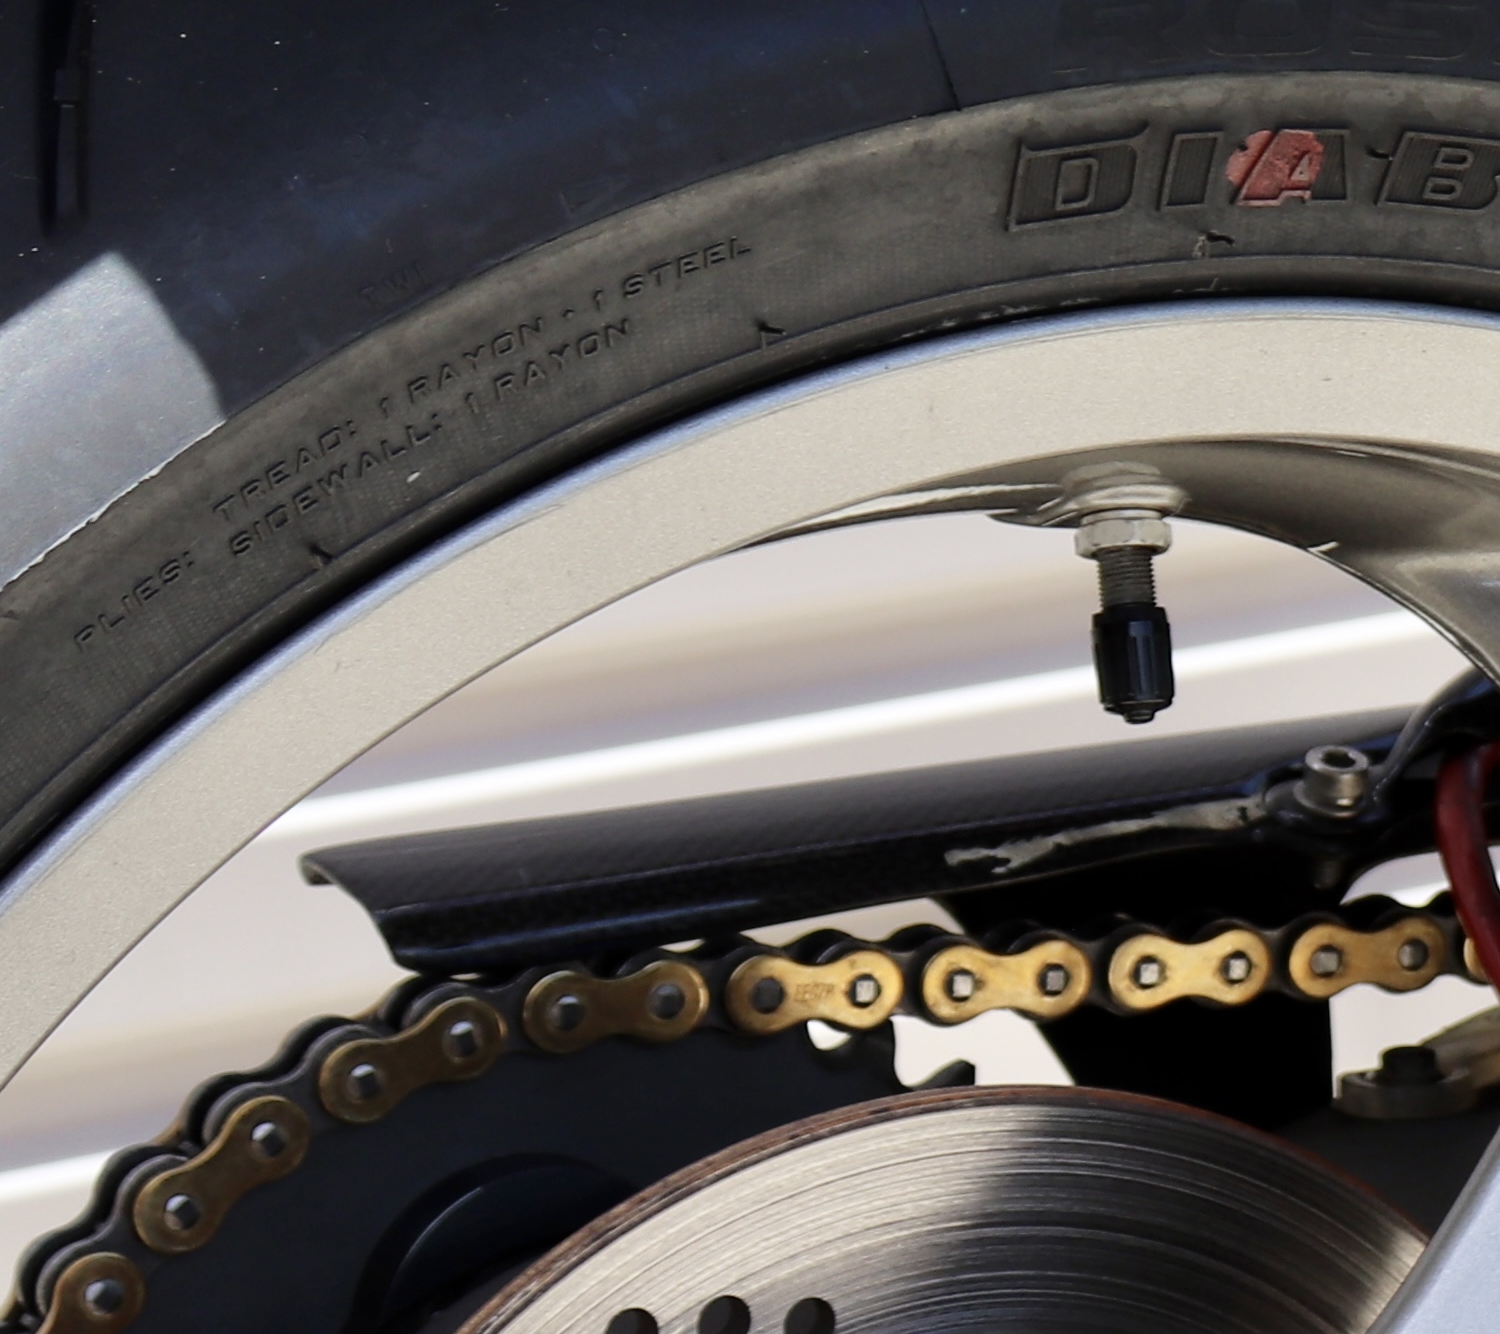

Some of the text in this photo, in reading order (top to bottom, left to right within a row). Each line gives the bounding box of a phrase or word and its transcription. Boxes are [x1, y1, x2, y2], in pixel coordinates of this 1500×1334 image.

[72, 317, 632, 655] PLIES: SIDEWALL: 1 RAYON
[212, 419, 357, 521] TREAD:
[379, 395, 391, 419] 1
[407, 315, 543, 404] RAYON
[591, 287, 605, 312] 1
[621, 235, 753, 300] STEEL
